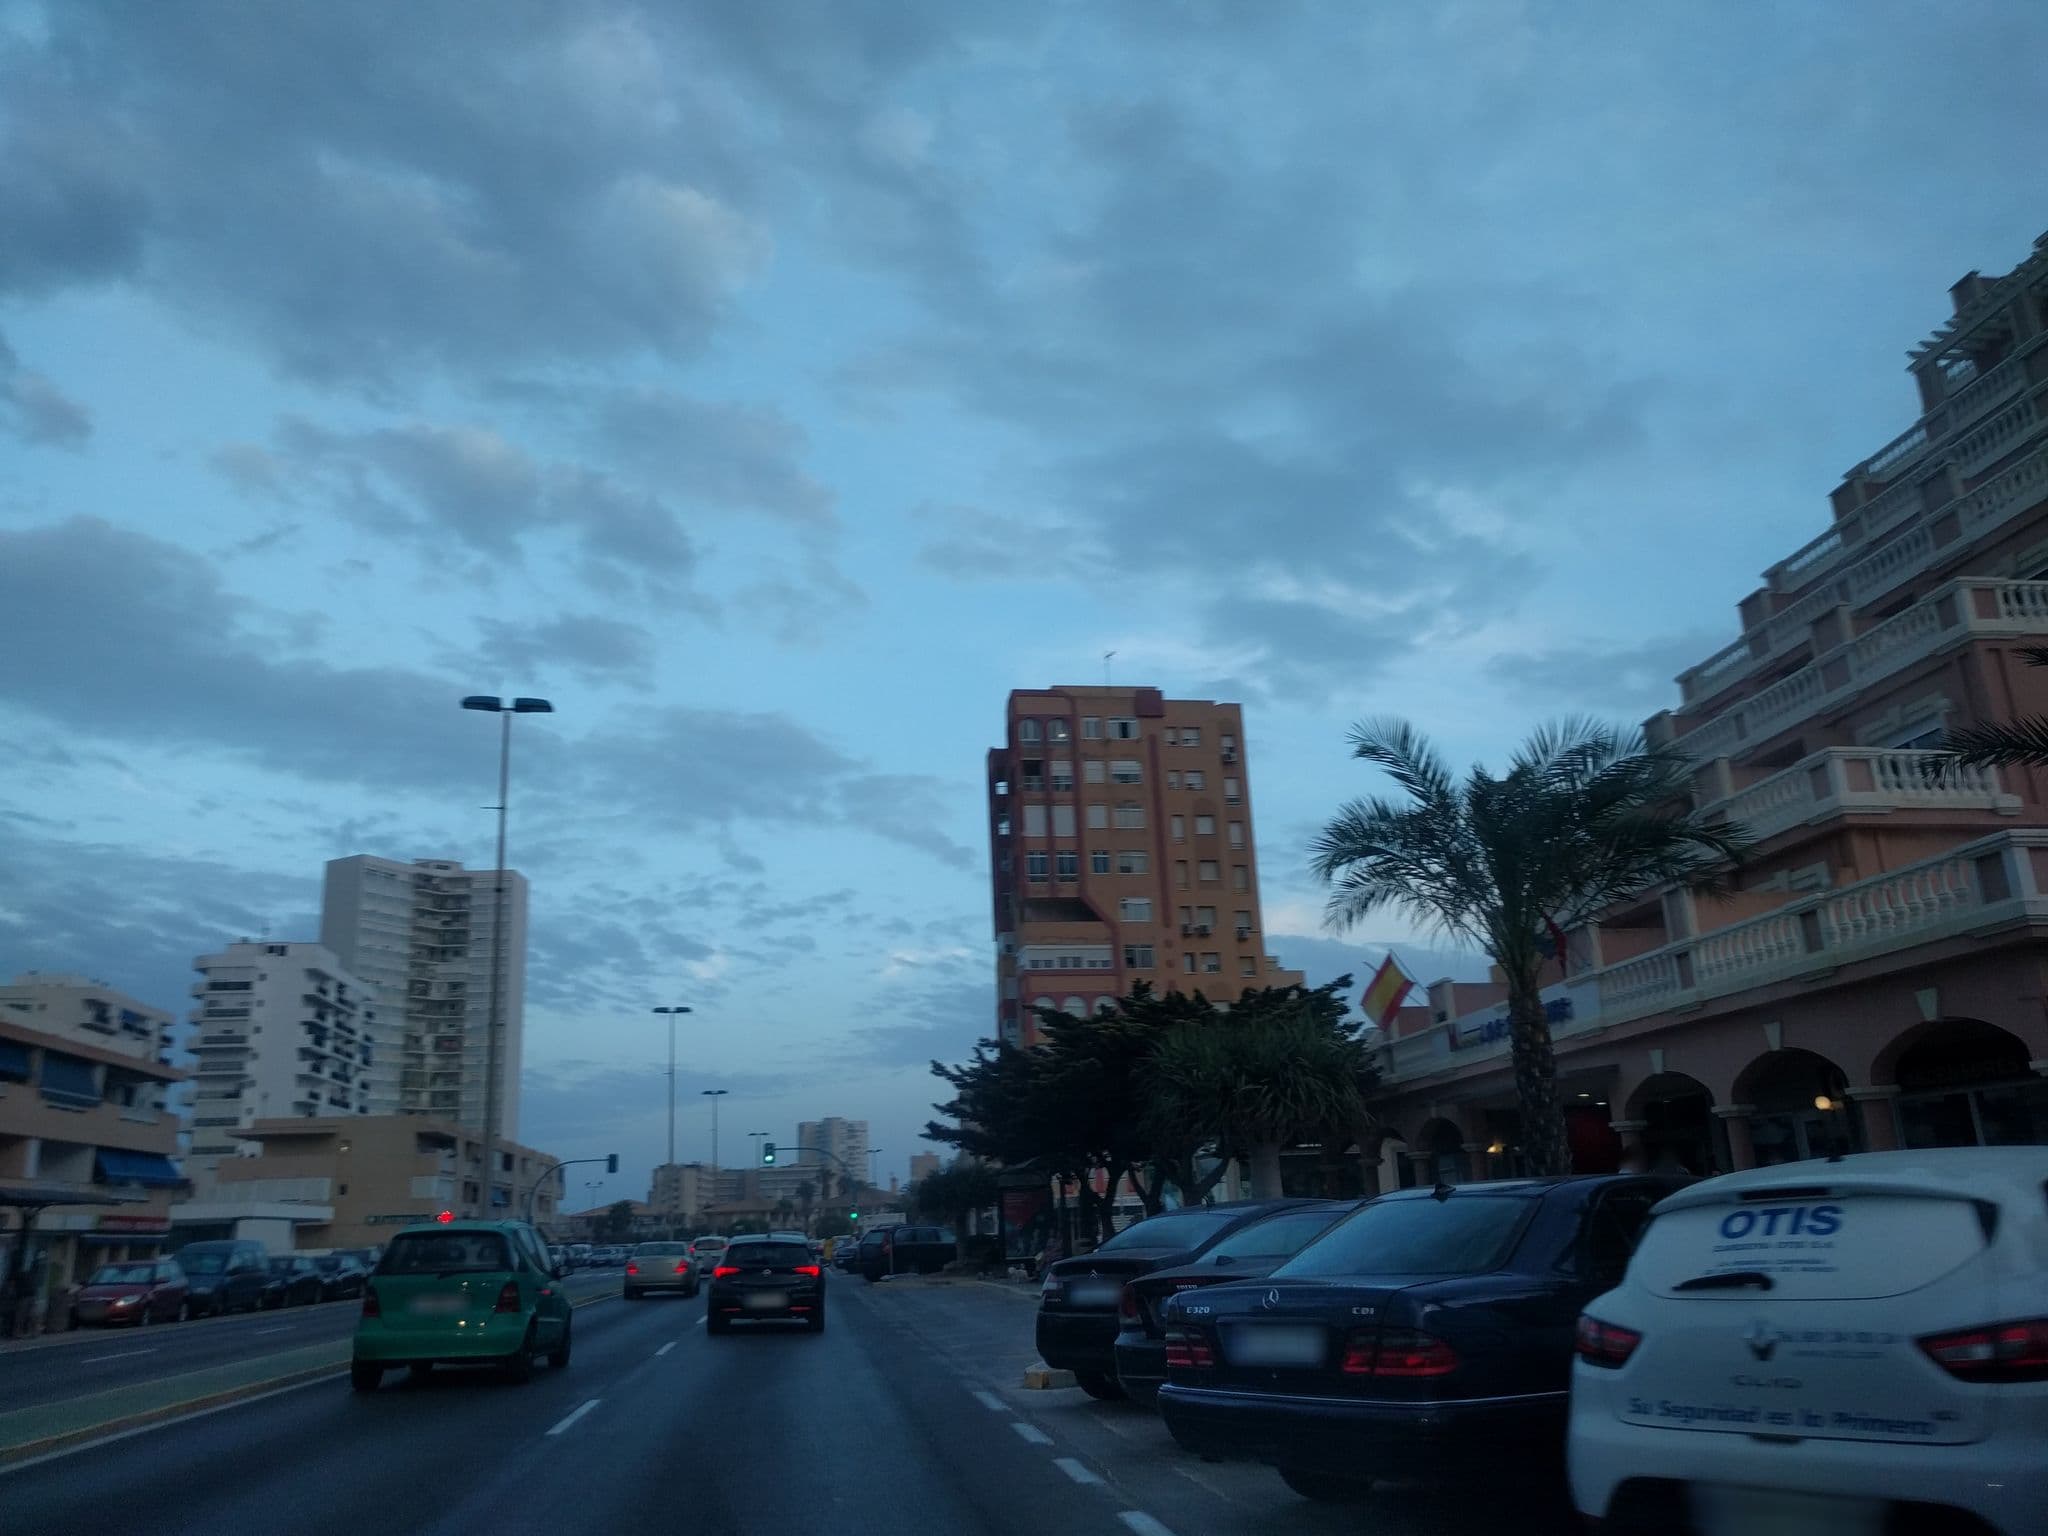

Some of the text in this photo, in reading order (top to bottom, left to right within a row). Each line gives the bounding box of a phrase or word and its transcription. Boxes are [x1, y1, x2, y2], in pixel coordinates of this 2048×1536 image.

[1720, 1205, 1843, 1239] OTIS
[1186, 1306, 1210, 1314] E320
[1351, 1306, 1375, 1315] CDI
